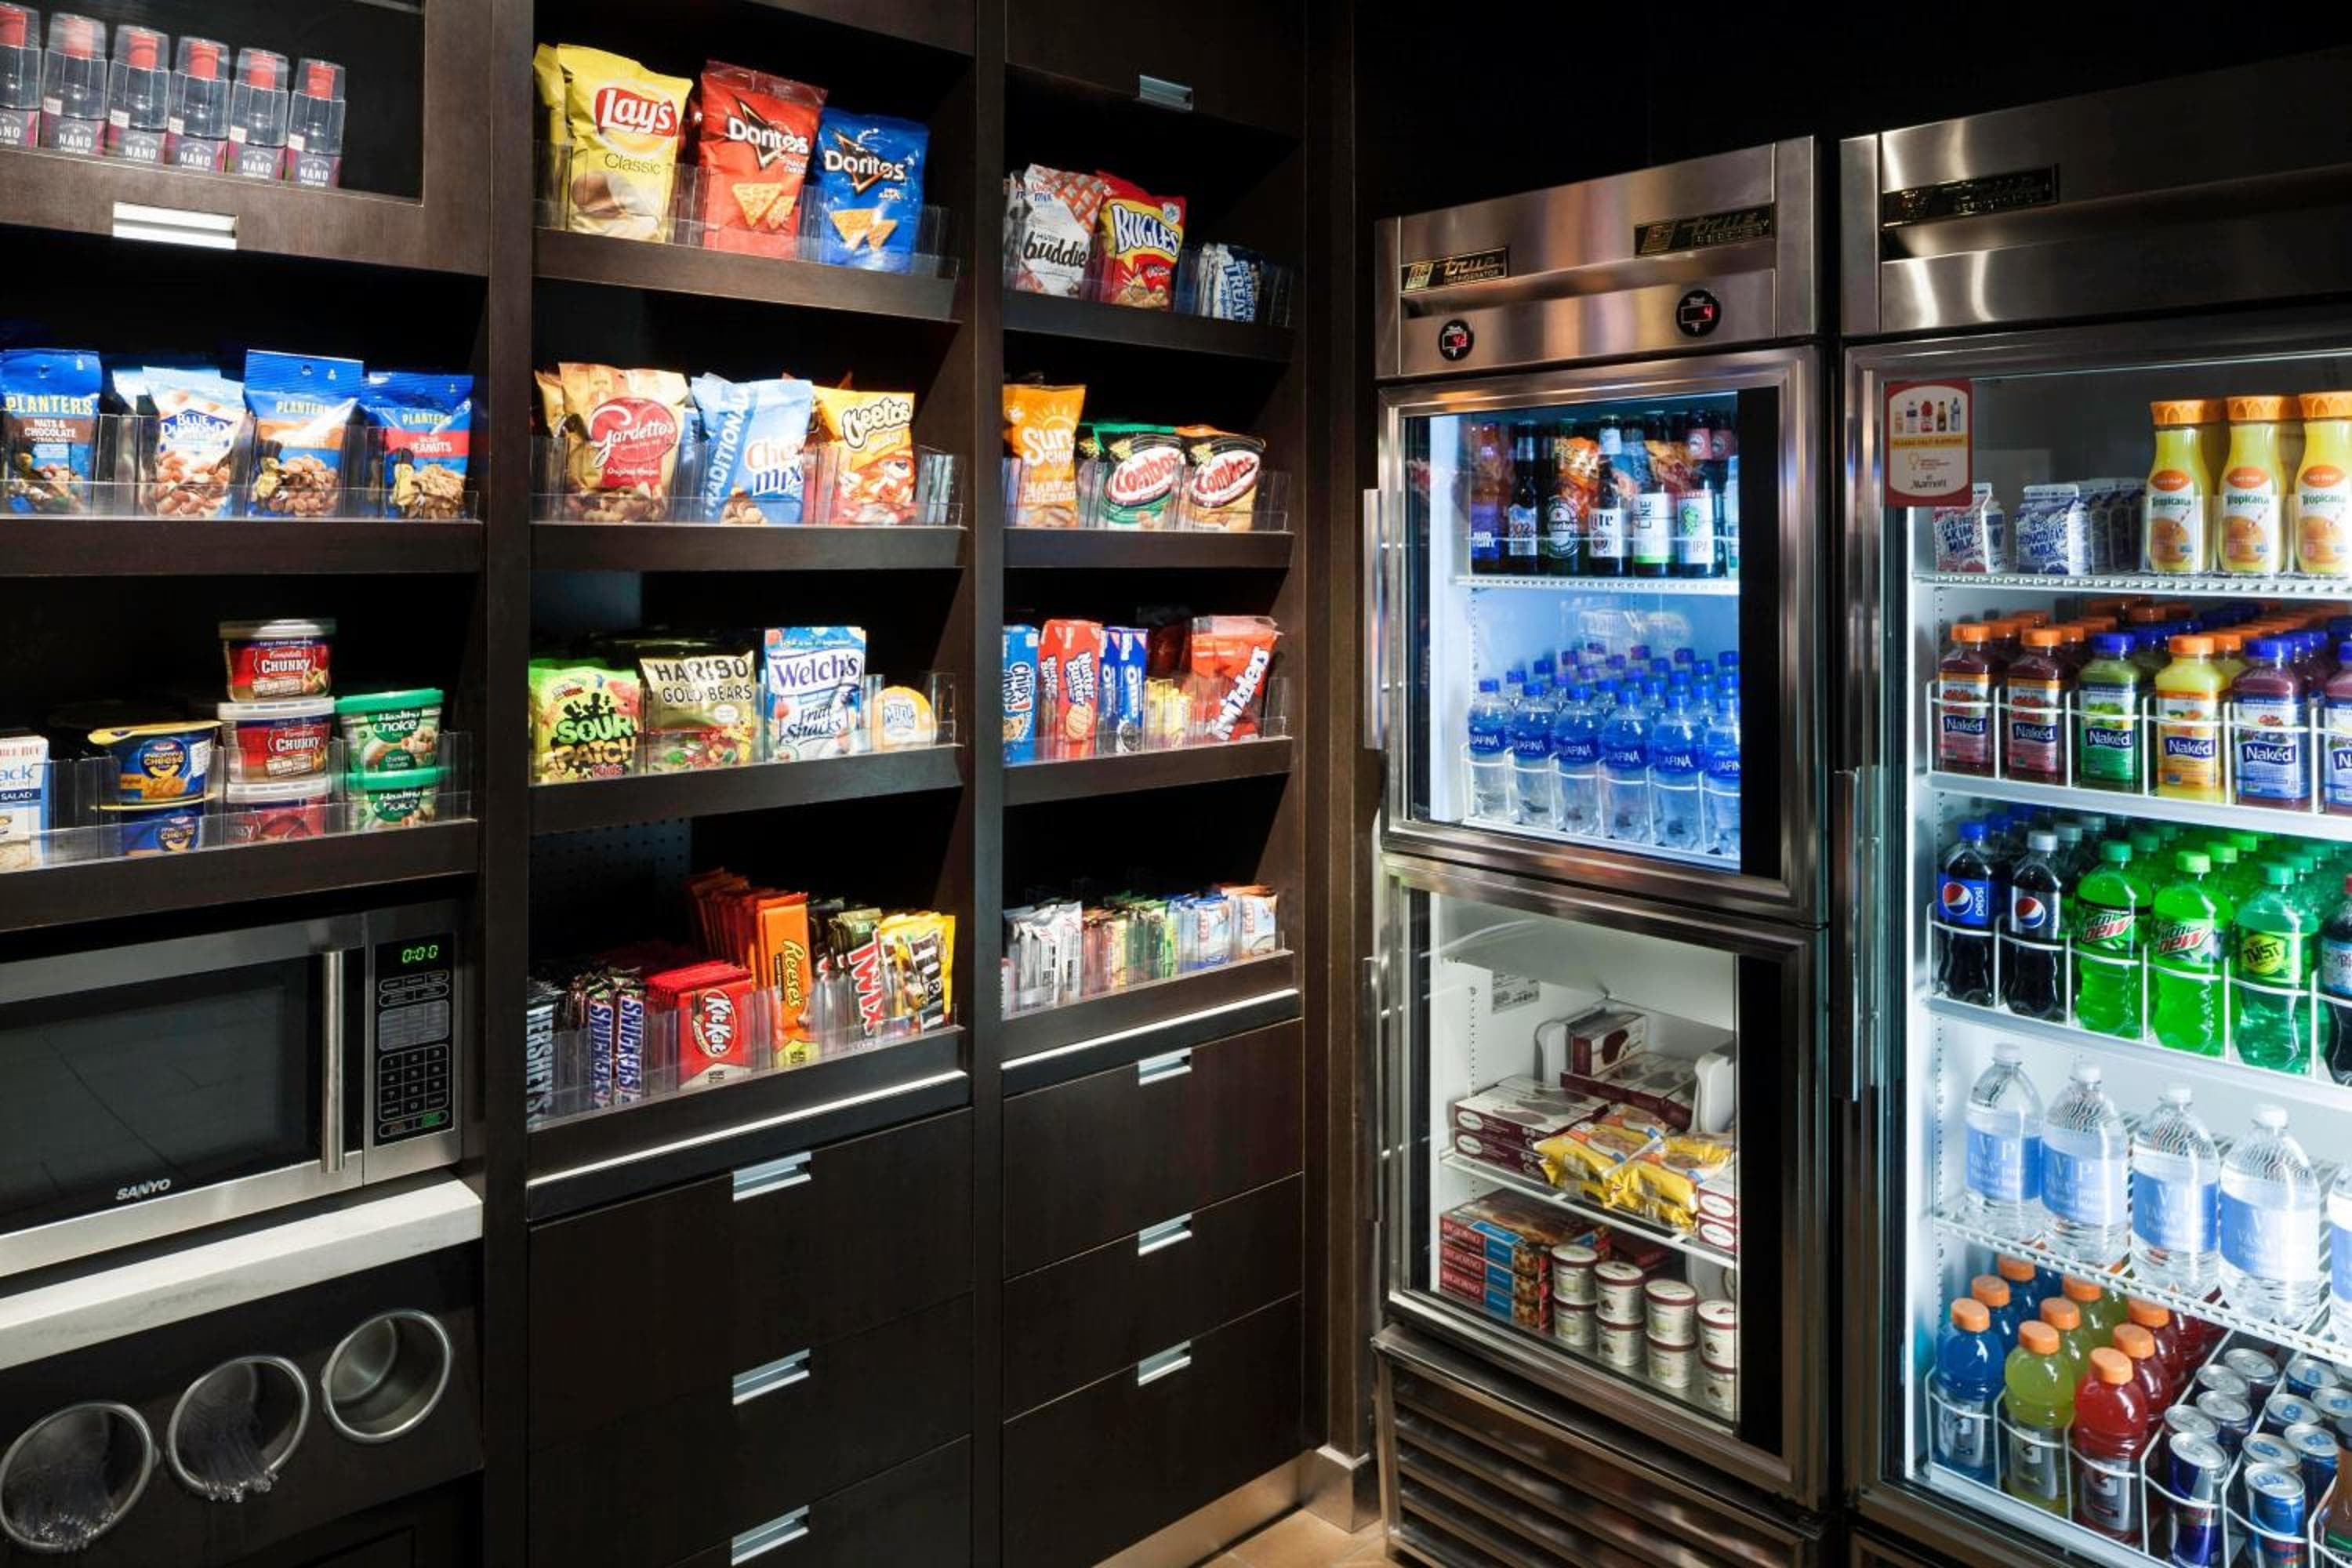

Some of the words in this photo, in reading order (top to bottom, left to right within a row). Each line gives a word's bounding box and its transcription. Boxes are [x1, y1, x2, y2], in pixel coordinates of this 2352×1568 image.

[601, 89, 673, 135] Lay's
[0, 125, 21, 138] NO
[59, 132, 93, 148] NANO
[726, 117, 809, 154] Doritos
[125, 145, 156, 160] NANO
[180, 152, 211, 166] NANO
[242, 160, 272, 174] NANO
[604, 153, 661, 175] Classic
[825, 150, 906, 181] Doritos
[300, 168, 328, 181] NANO
[1112, 205, 1178, 257] BUGLES
[5, 395, 93, 415] PLANTERS
[276, 401, 326, 415] PLANTE
[34, 419, 60, 429] NUTS
[176, 413, 209, 425] BLUE
[842, 397, 910, 449] Cheetos
[24, 427, 76, 439] CHOCOLATE
[1115, 452, 1176, 493] Combos
[1194, 455, 1252, 493] Combos
[1911, 478, 1947, 490] Marriott
[2227, 494, 2270, 506] Tropicana
[261, 659, 310, 673] CHUNKY
[655, 657, 749, 683] HARIBO
[774, 654, 858, 688] Welch's
[1011, 663, 1030, 702] Chips
[662, 688, 703, 703] GOLD
[709, 684, 753, 701] BEARS
[372, 720, 416, 733] Choice
[557, 714, 633, 744] SOUR
[276, 736, 320, 753] CHUNKY
[2169, 739, 2214, 755] Naked
[2246, 745, 2293, 762] Naked
[1974, 887, 1985, 916] pepsi
[402, 945, 439, 964] 0:00
[782, 938, 806, 1008] Reese's
[848, 929, 884, 1036] TWIX
[590, 1004, 613, 1095] SNICKERS
[619, 1000, 643, 1090] SNICKERS
[115, 1178, 172, 1200] SANYO
